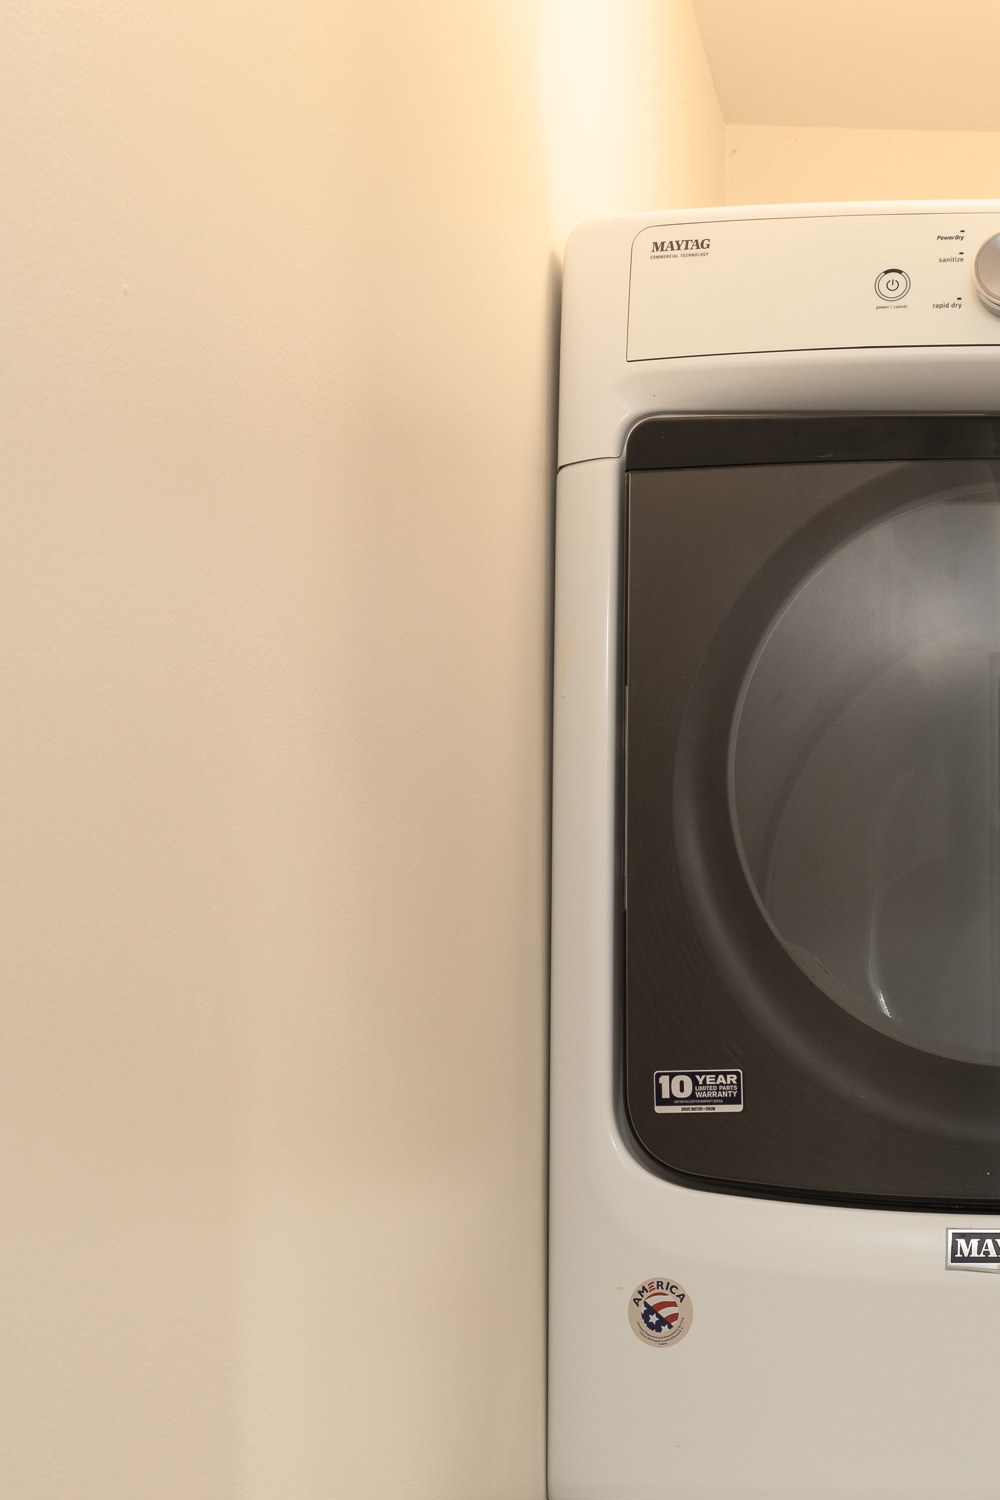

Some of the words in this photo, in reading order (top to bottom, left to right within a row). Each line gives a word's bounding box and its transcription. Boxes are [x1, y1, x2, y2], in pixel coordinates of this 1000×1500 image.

[651, 238, 711, 252] MAYTAG
[659, 1075, 693, 1099] 10
[695, 1074, 738, 1085] YEAR
[632, 1280, 686, 1307] AMERICA
